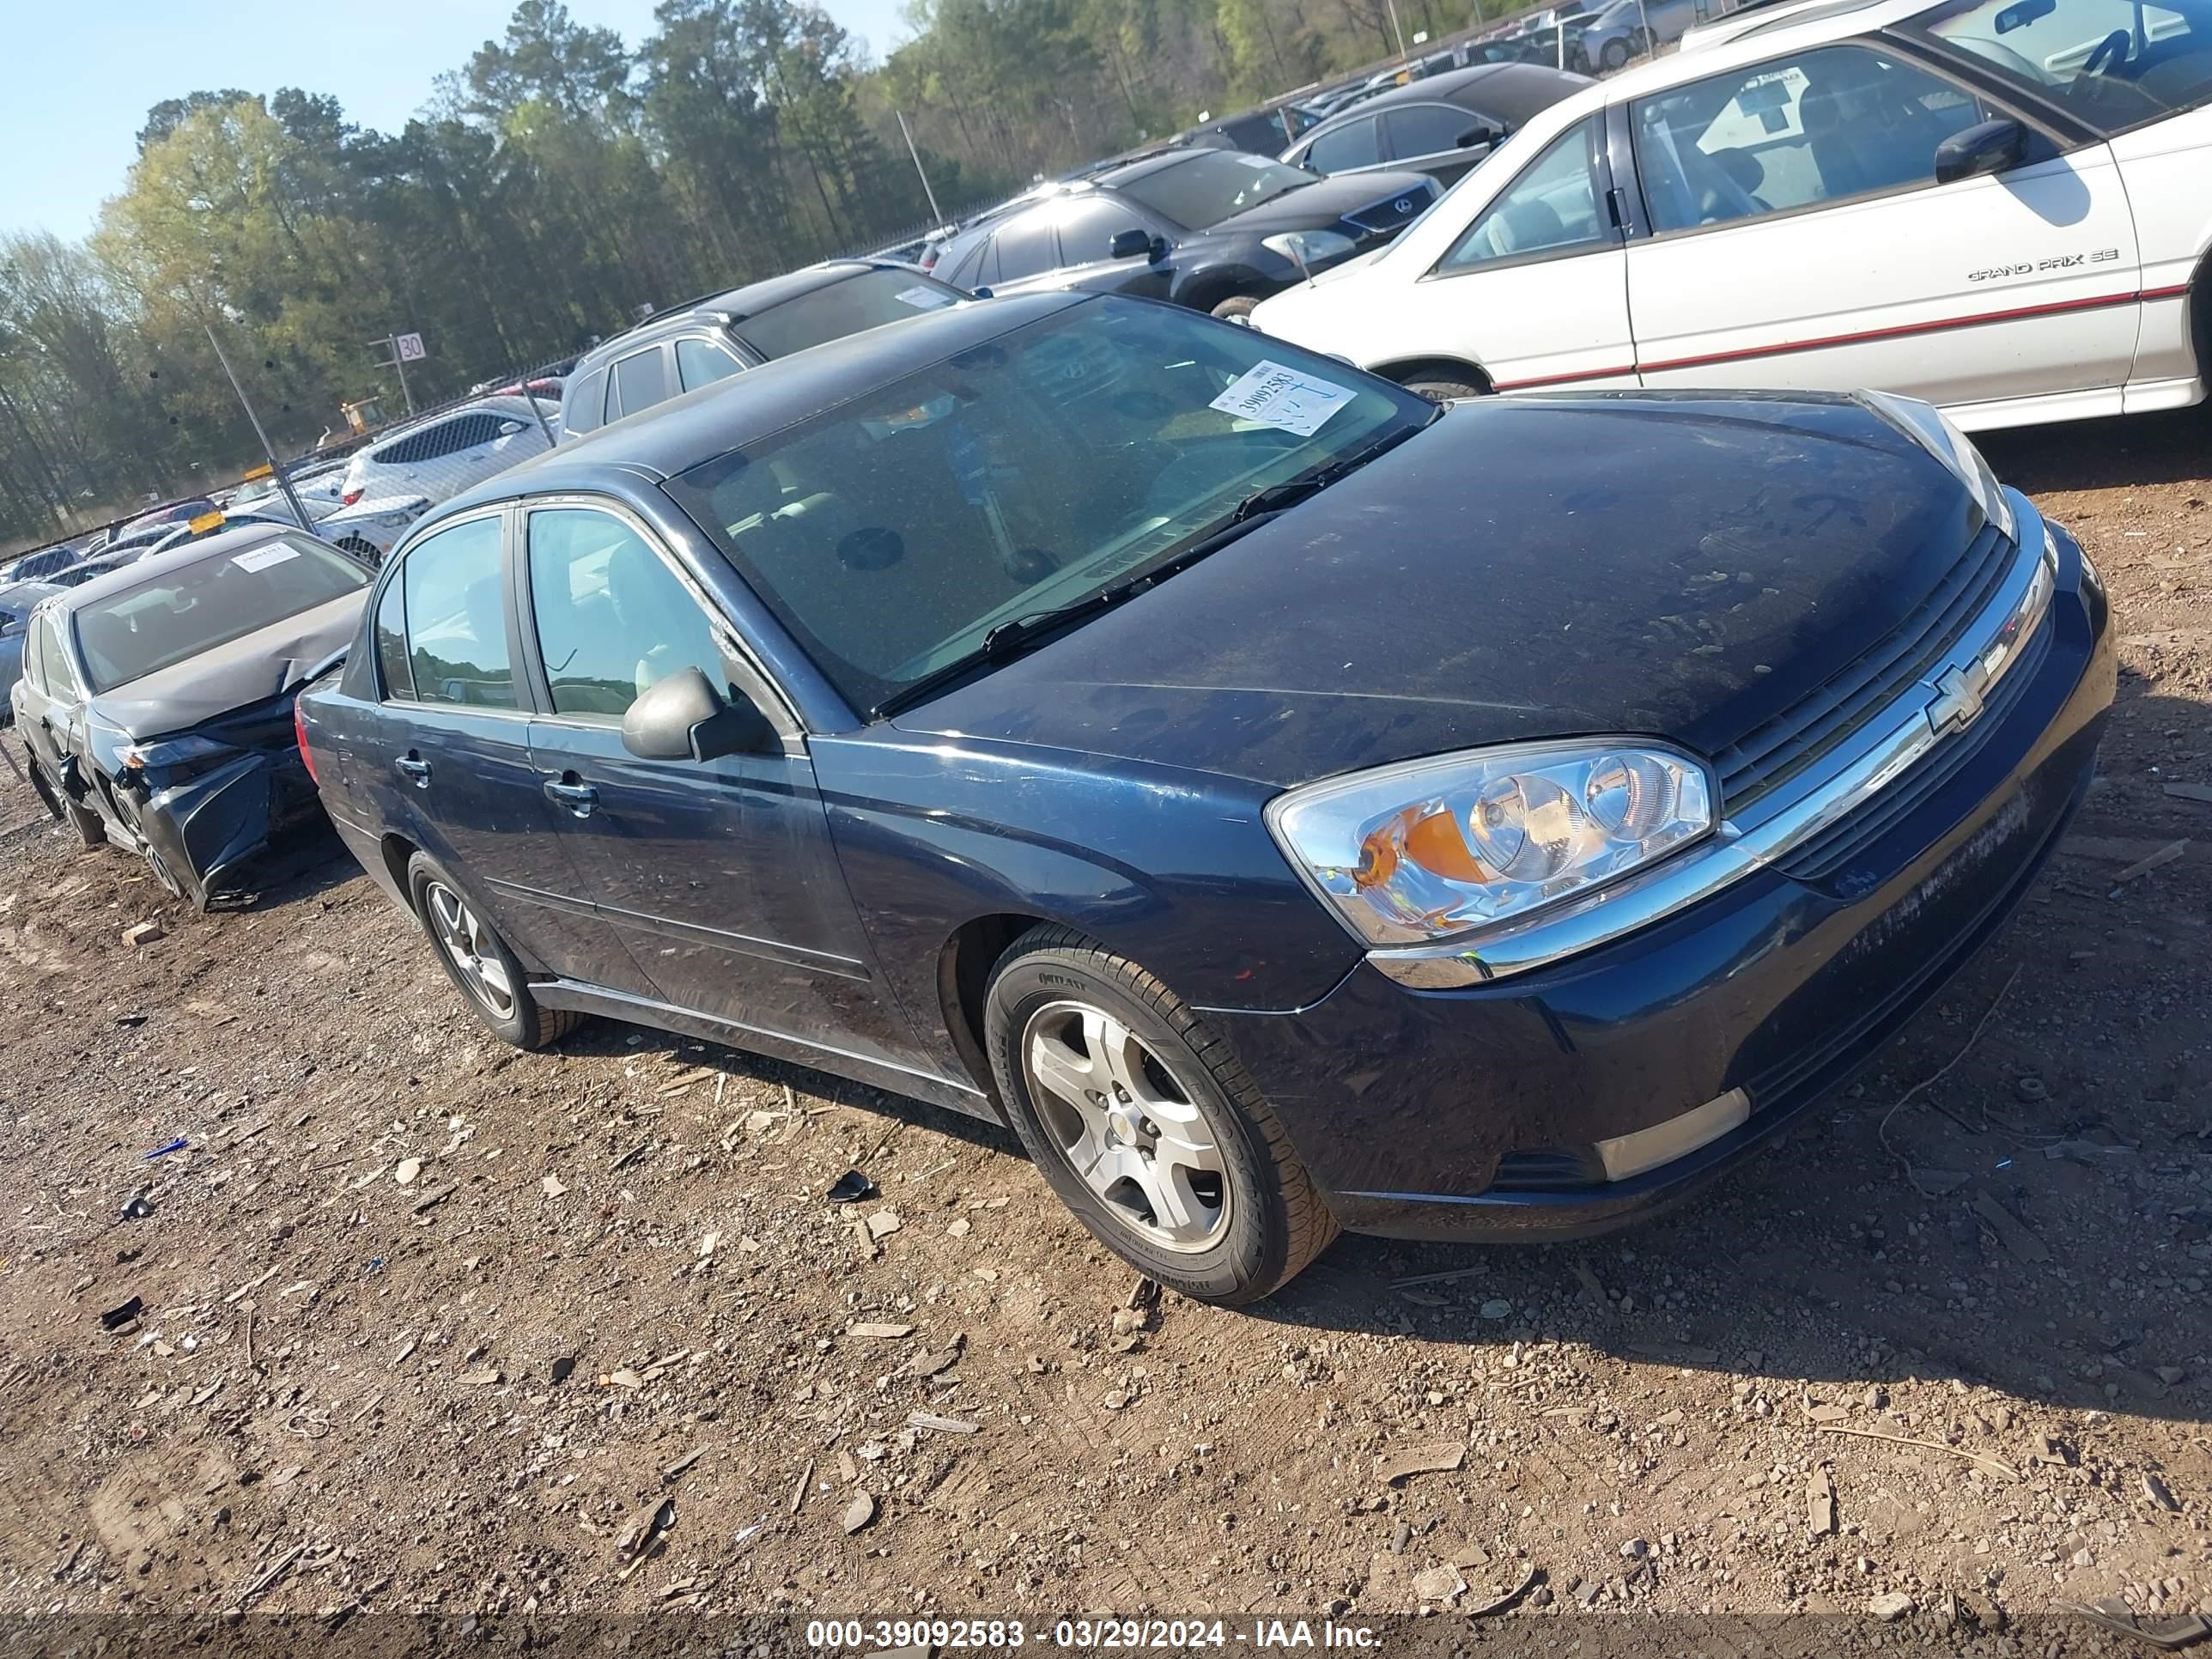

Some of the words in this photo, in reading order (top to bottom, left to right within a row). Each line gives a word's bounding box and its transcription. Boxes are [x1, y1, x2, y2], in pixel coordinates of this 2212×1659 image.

[1967, 262, 2033, 283] GRAND
[2038, 254, 2085, 272] PRIX
[2089, 248, 2119, 263] SE
[401, 337, 422, 358] 30
[1238, 372, 1295, 413] 39092583
